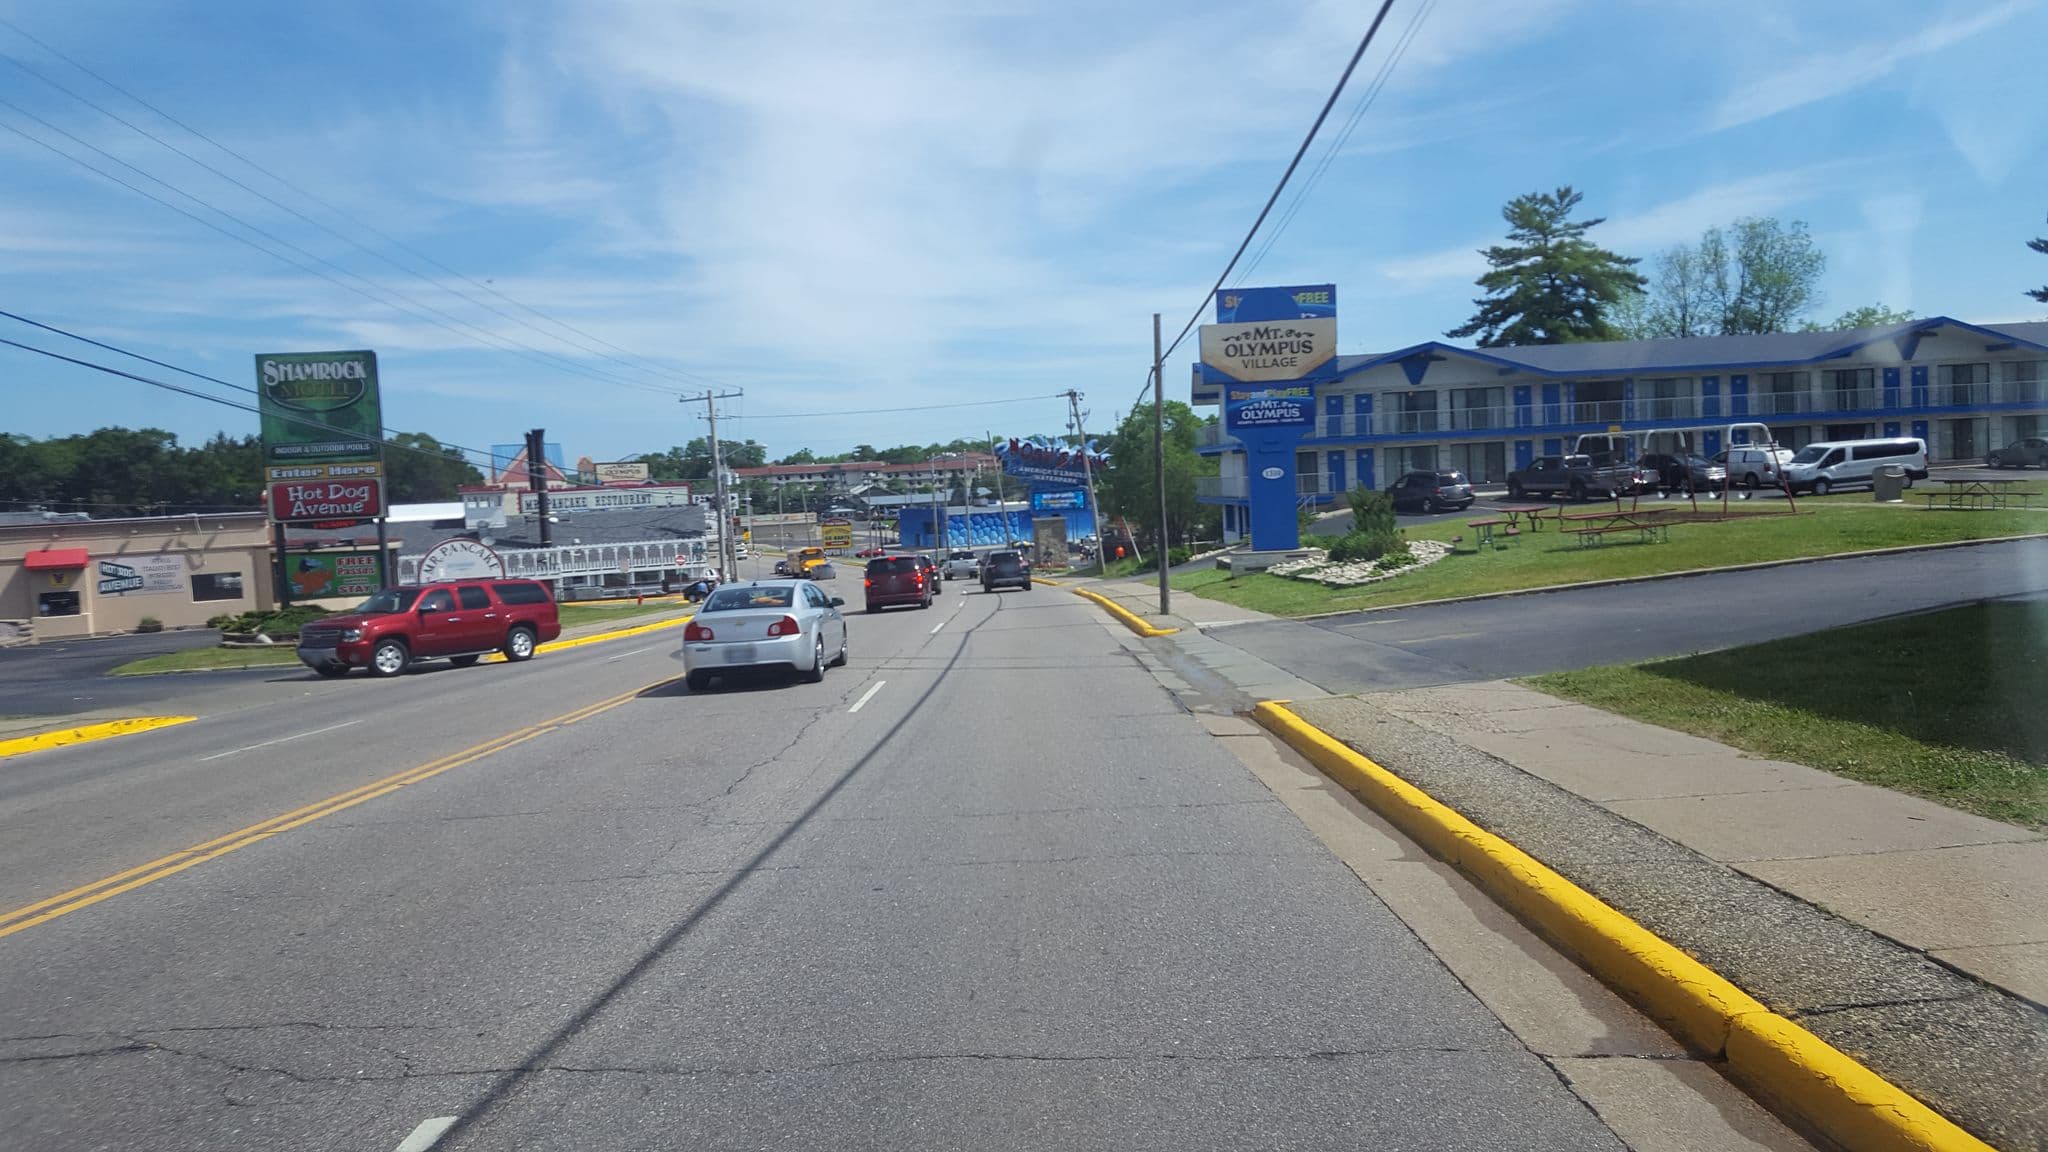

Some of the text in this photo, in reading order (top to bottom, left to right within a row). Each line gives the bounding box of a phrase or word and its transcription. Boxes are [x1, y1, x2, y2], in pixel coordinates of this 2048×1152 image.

[1225, 341, 1313, 358] OLYMPUS
[1242, 357, 1298, 369] VILLAGE
[1241, 408, 1300, 420] OLYMPUS
[312, 443, 345, 453] OUTDOOR
[346, 442, 371, 451] POOLS
[271, 465, 375, 478] Enter Here
[287, 484, 370, 502] Hot Dog
[291, 501, 364, 516] Avenue
[549, 497, 587, 509] PANCAKE
[595, 494, 652, 506] RESTAURANT
[440, 543, 500, 570] PANCAKE
[102, 563, 117, 575] HOT
[101, 576, 144, 591] AVENUE
